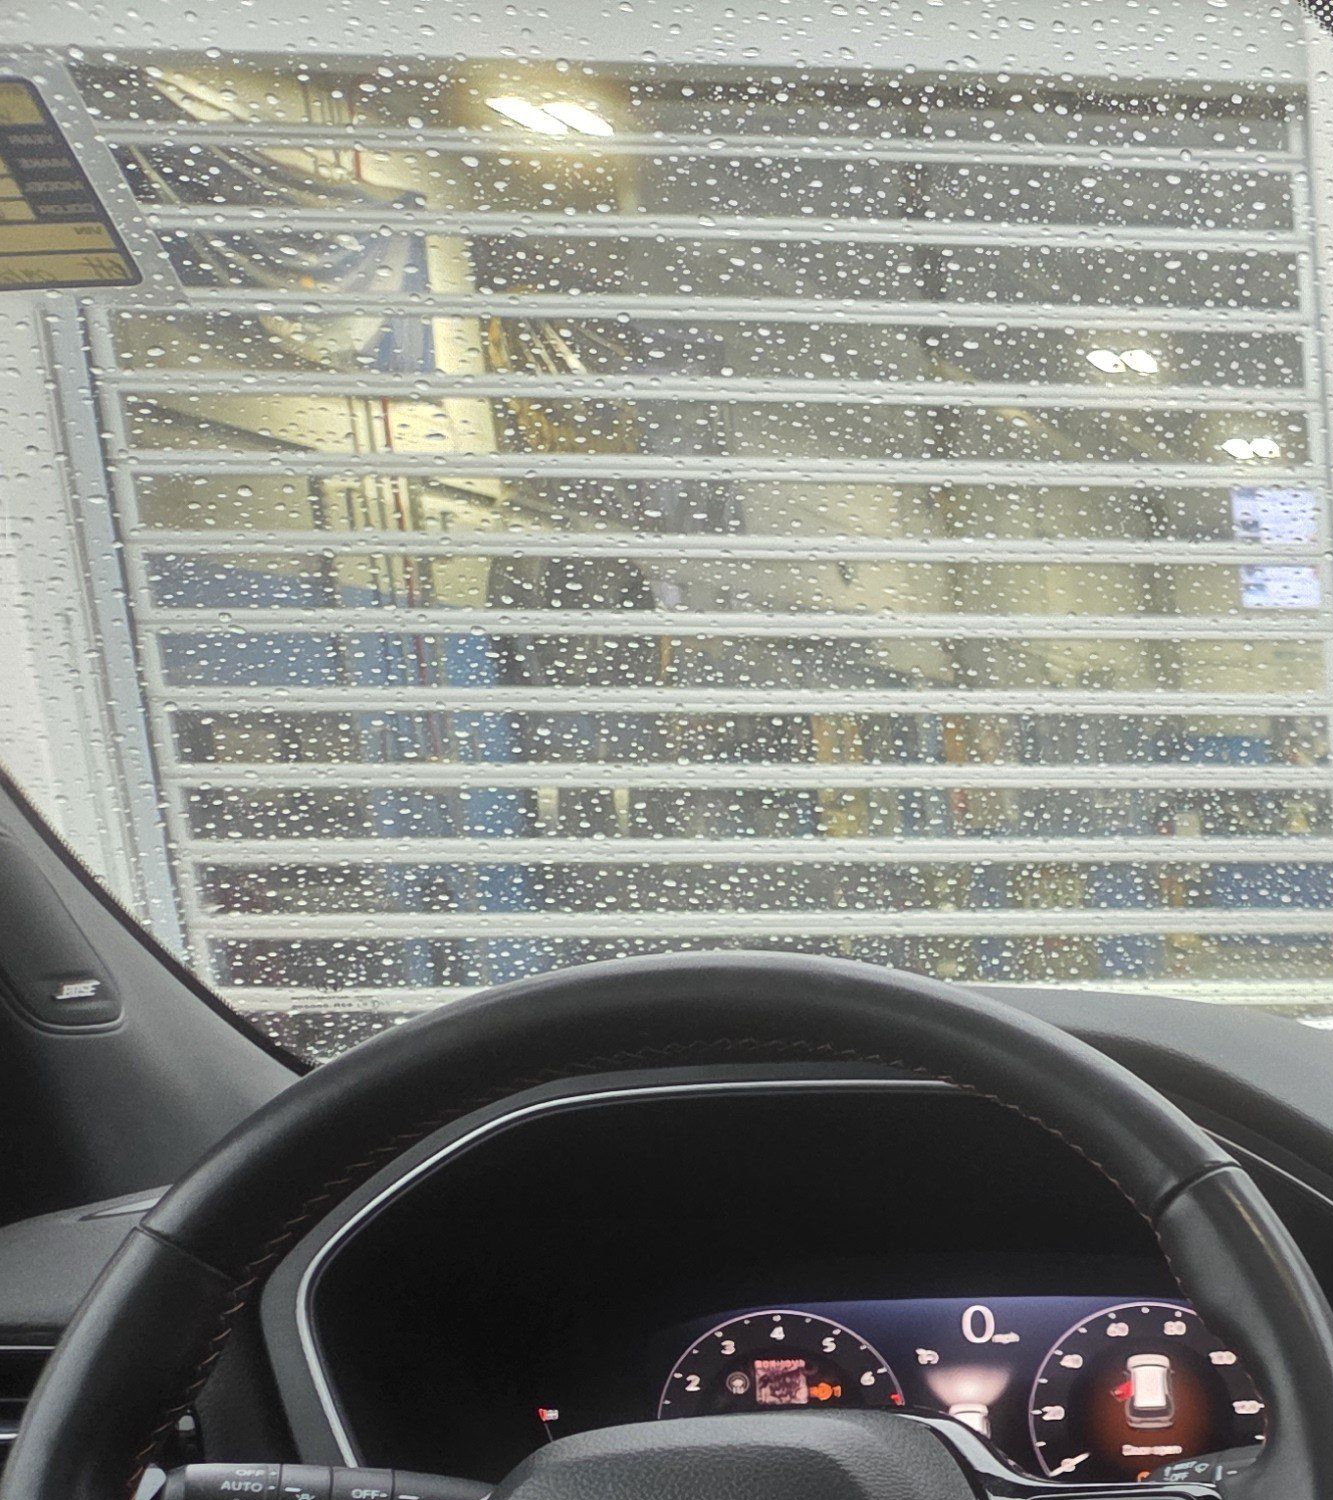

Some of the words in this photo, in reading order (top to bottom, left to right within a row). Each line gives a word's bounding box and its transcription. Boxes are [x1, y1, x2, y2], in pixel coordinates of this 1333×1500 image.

[961, 1304, 995, 1343] 0
[770, 1326, 785, 1341] 4
[721, 1339, 735, 1355] 3
[822, 1336, 837, 1353] 5
[685, 1374, 701, 1392] 2
[860, 1371, 875, 1386] 6
[235, 1469, 266, 1477] OFF
[220, 1480, 263, 1492] AUTO
[351, 1488, 380, 1499] OFF
